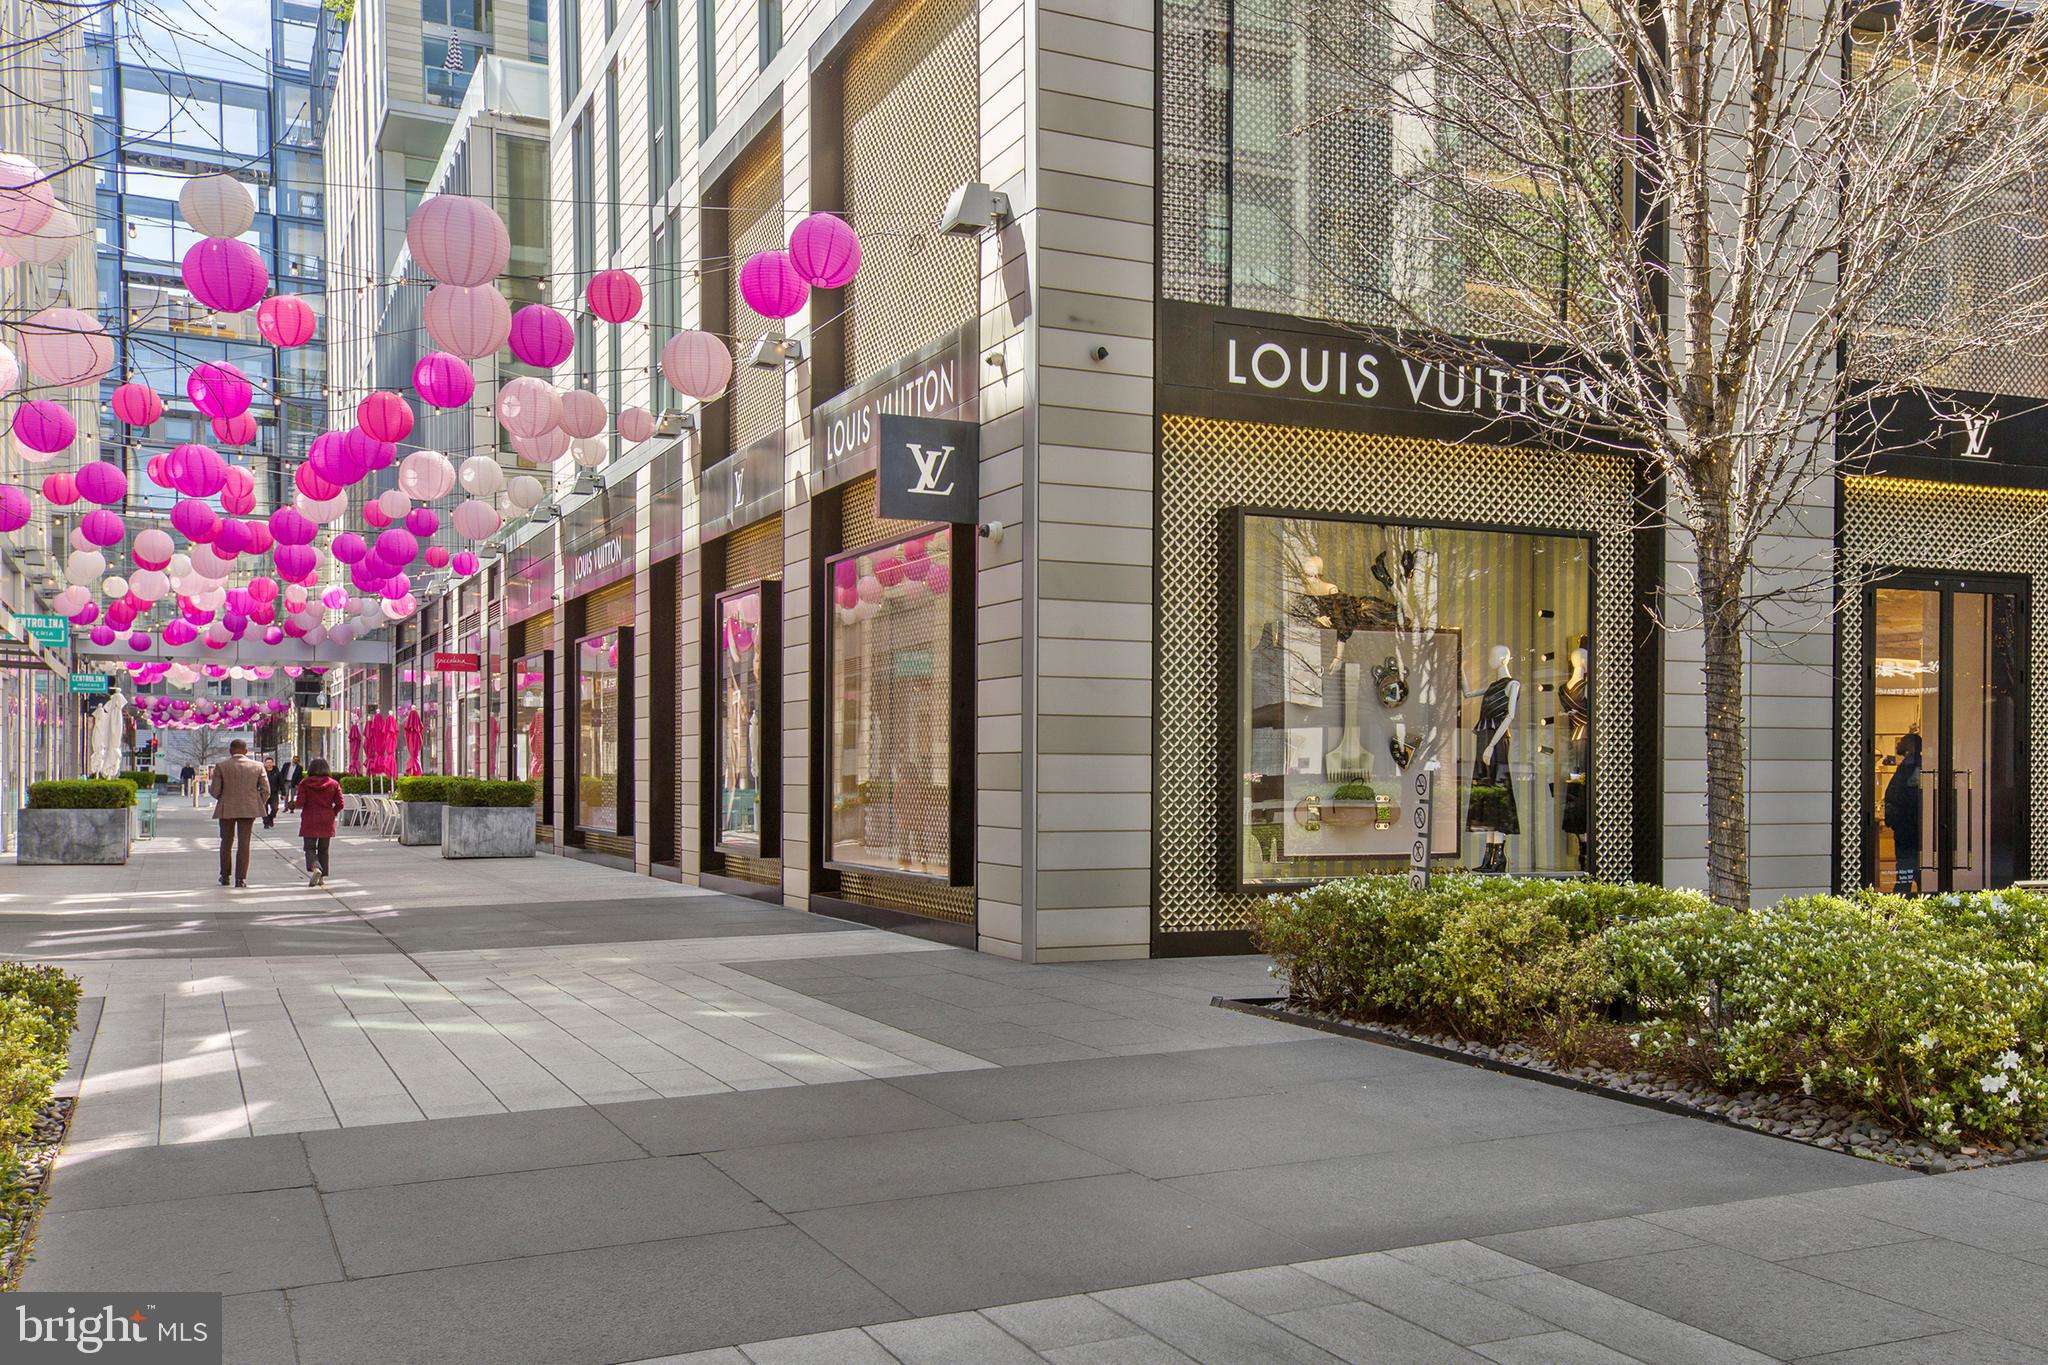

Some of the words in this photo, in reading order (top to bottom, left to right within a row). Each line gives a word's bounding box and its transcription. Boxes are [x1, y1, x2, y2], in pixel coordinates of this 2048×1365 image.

[1229, 339, 1380, 399] LOUIS
[1401, 358, 1609, 420] VUITTON
[827, 404, 870, 461] LOUIS
[575, 550, 592, 580] LOUIS
[593, 535, 622, 570] VUITTON
[15, 617, 64, 629] ENTROLINA
[71, 674, 105, 683] CENTROLINA
